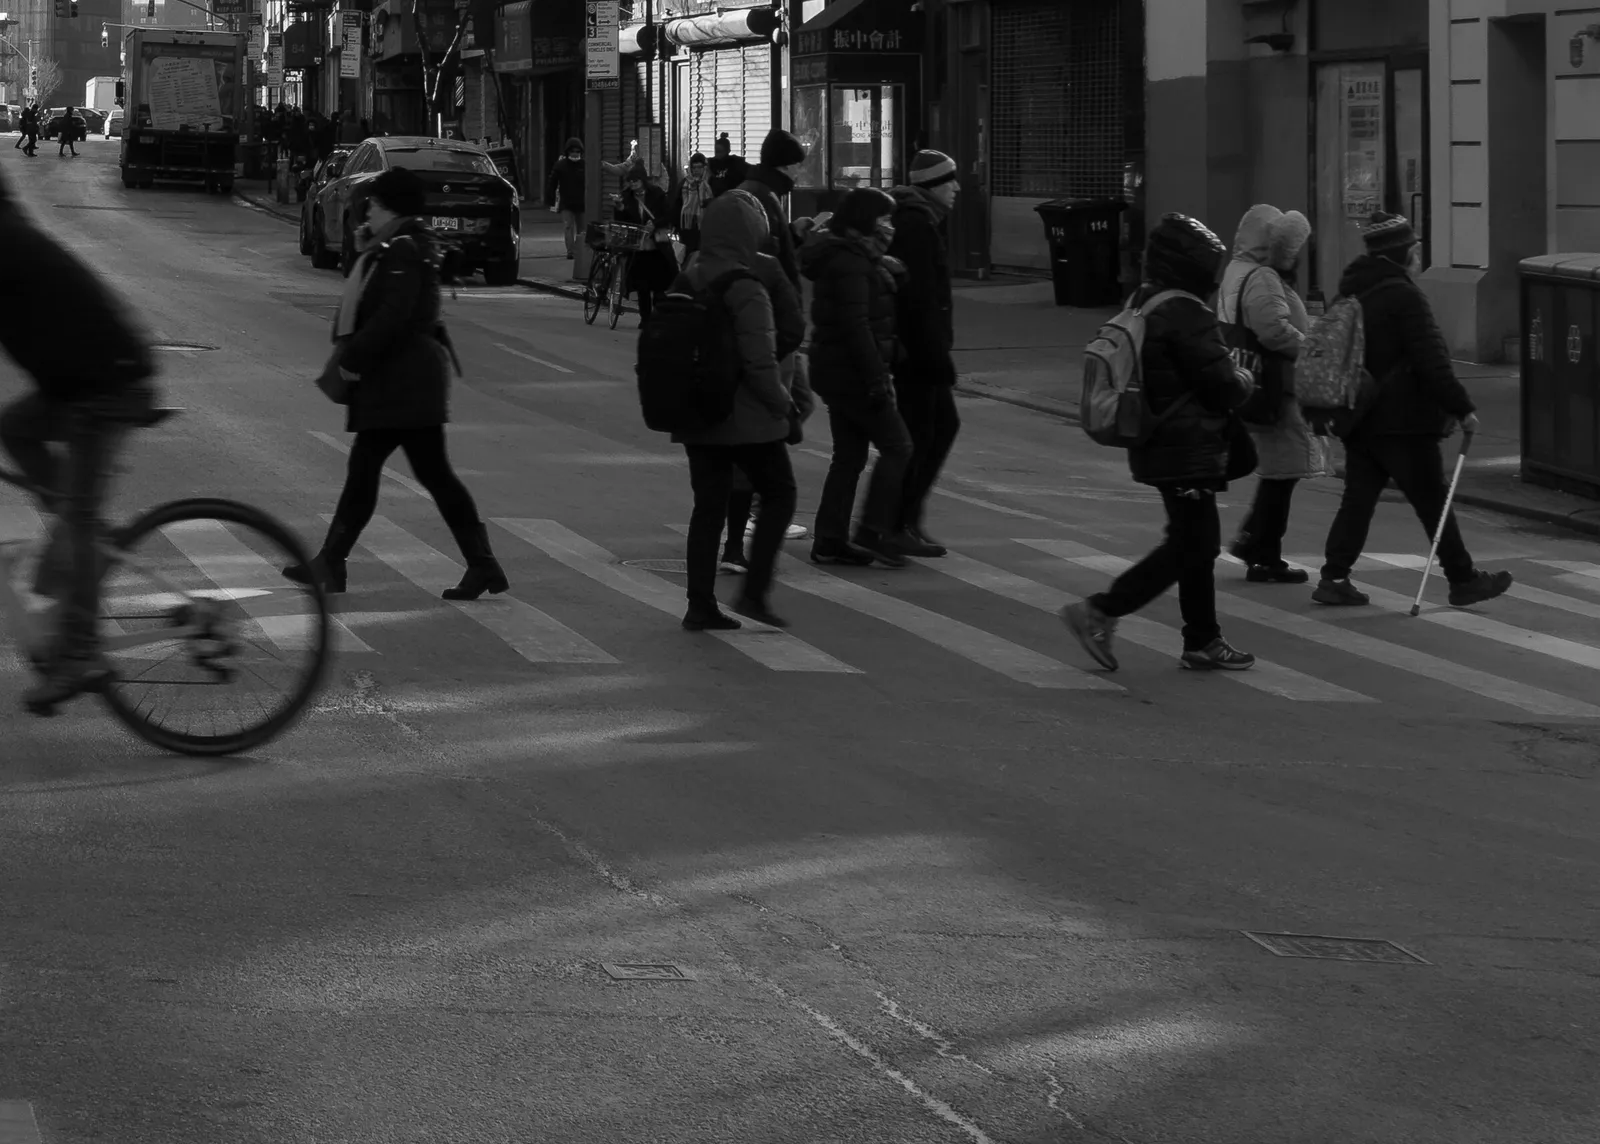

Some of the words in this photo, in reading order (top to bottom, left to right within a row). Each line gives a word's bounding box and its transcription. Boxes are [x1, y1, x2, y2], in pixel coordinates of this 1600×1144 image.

[588, 27, 595, 37] 3
[1052, 226, 1064, 236] 114
[1090, 220, 1108, 232] 114
